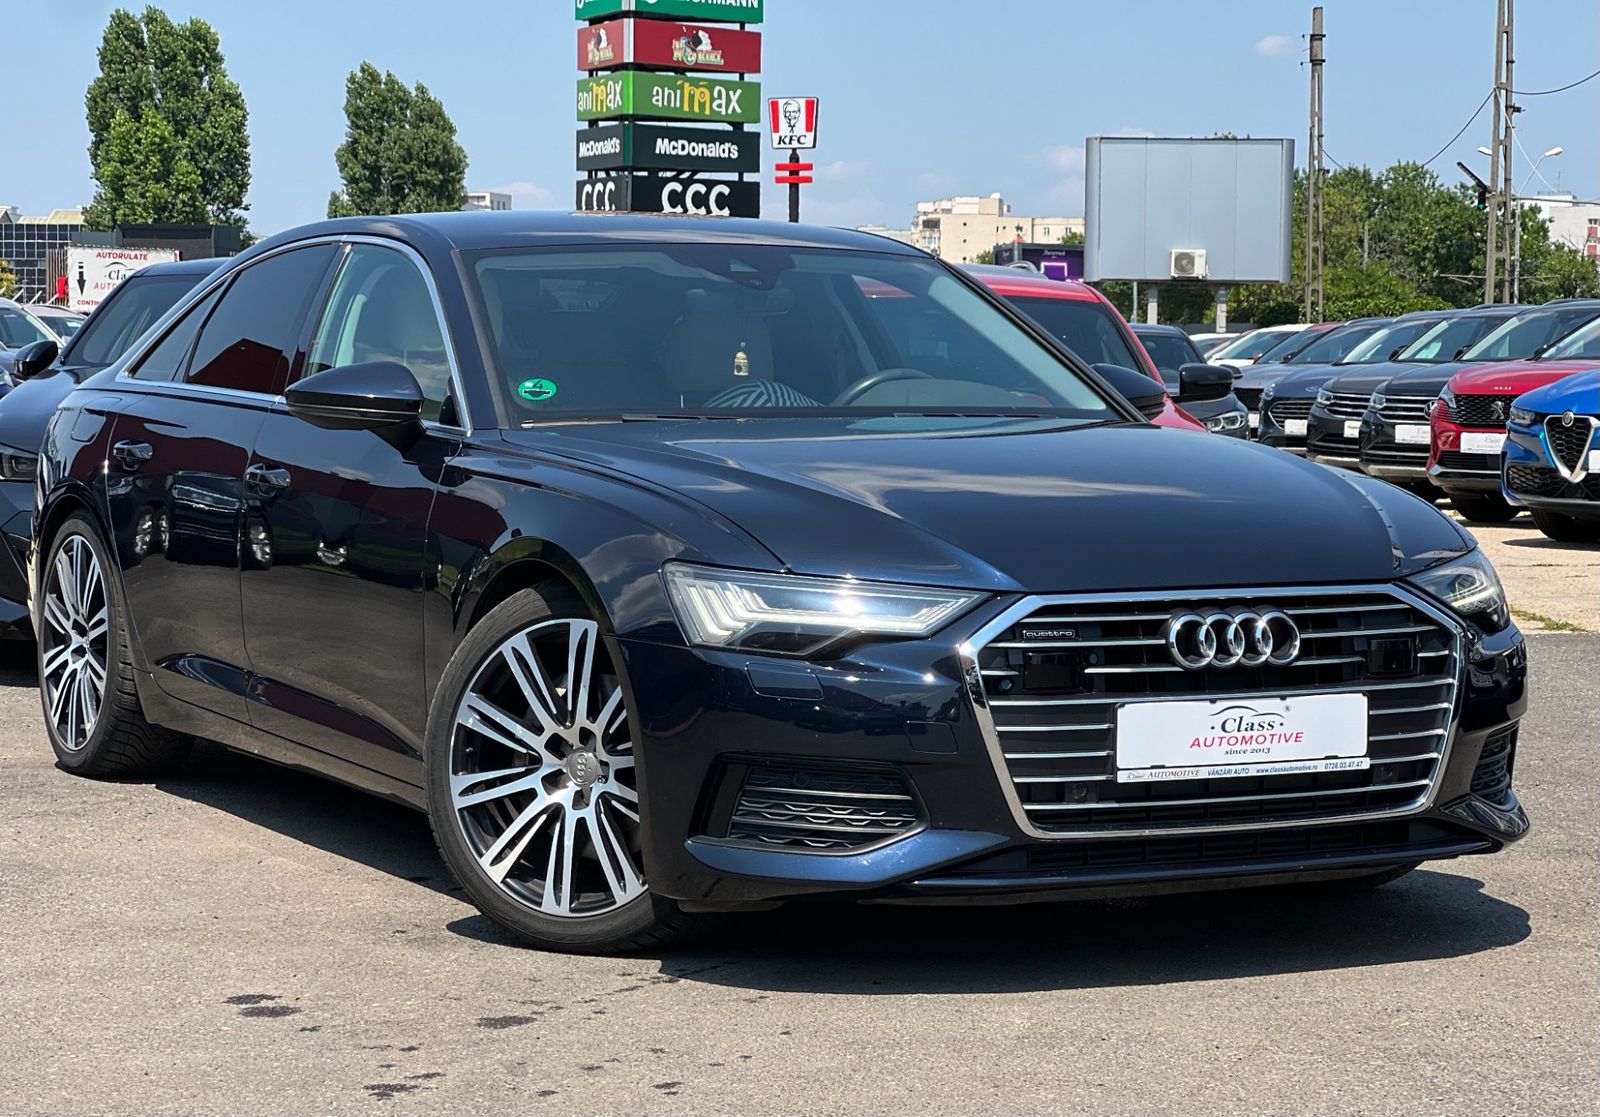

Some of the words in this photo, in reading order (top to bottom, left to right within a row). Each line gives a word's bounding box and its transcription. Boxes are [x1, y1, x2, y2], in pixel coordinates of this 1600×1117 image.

[578, 79, 622, 112] animax
[652, 81, 742, 115] animax
[579, 137, 620, 158] McDonald's
[777, 134, 807, 145] KFC
[655, 137, 739, 159] McDonald's
[661, 181, 731, 216] CCC
[96, 252, 149, 260] AUTORULATE
[108, 270, 127, 280] Cla
[1220, 716, 1275, 733] Class
[1190, 732, 1304, 748] AUTOMOTIVE
[1225, 747, 1249, 755] since
[1147, 769, 1201, 778] AUTOMOTIVE
[1233, 767, 1250, 775] AUTO
